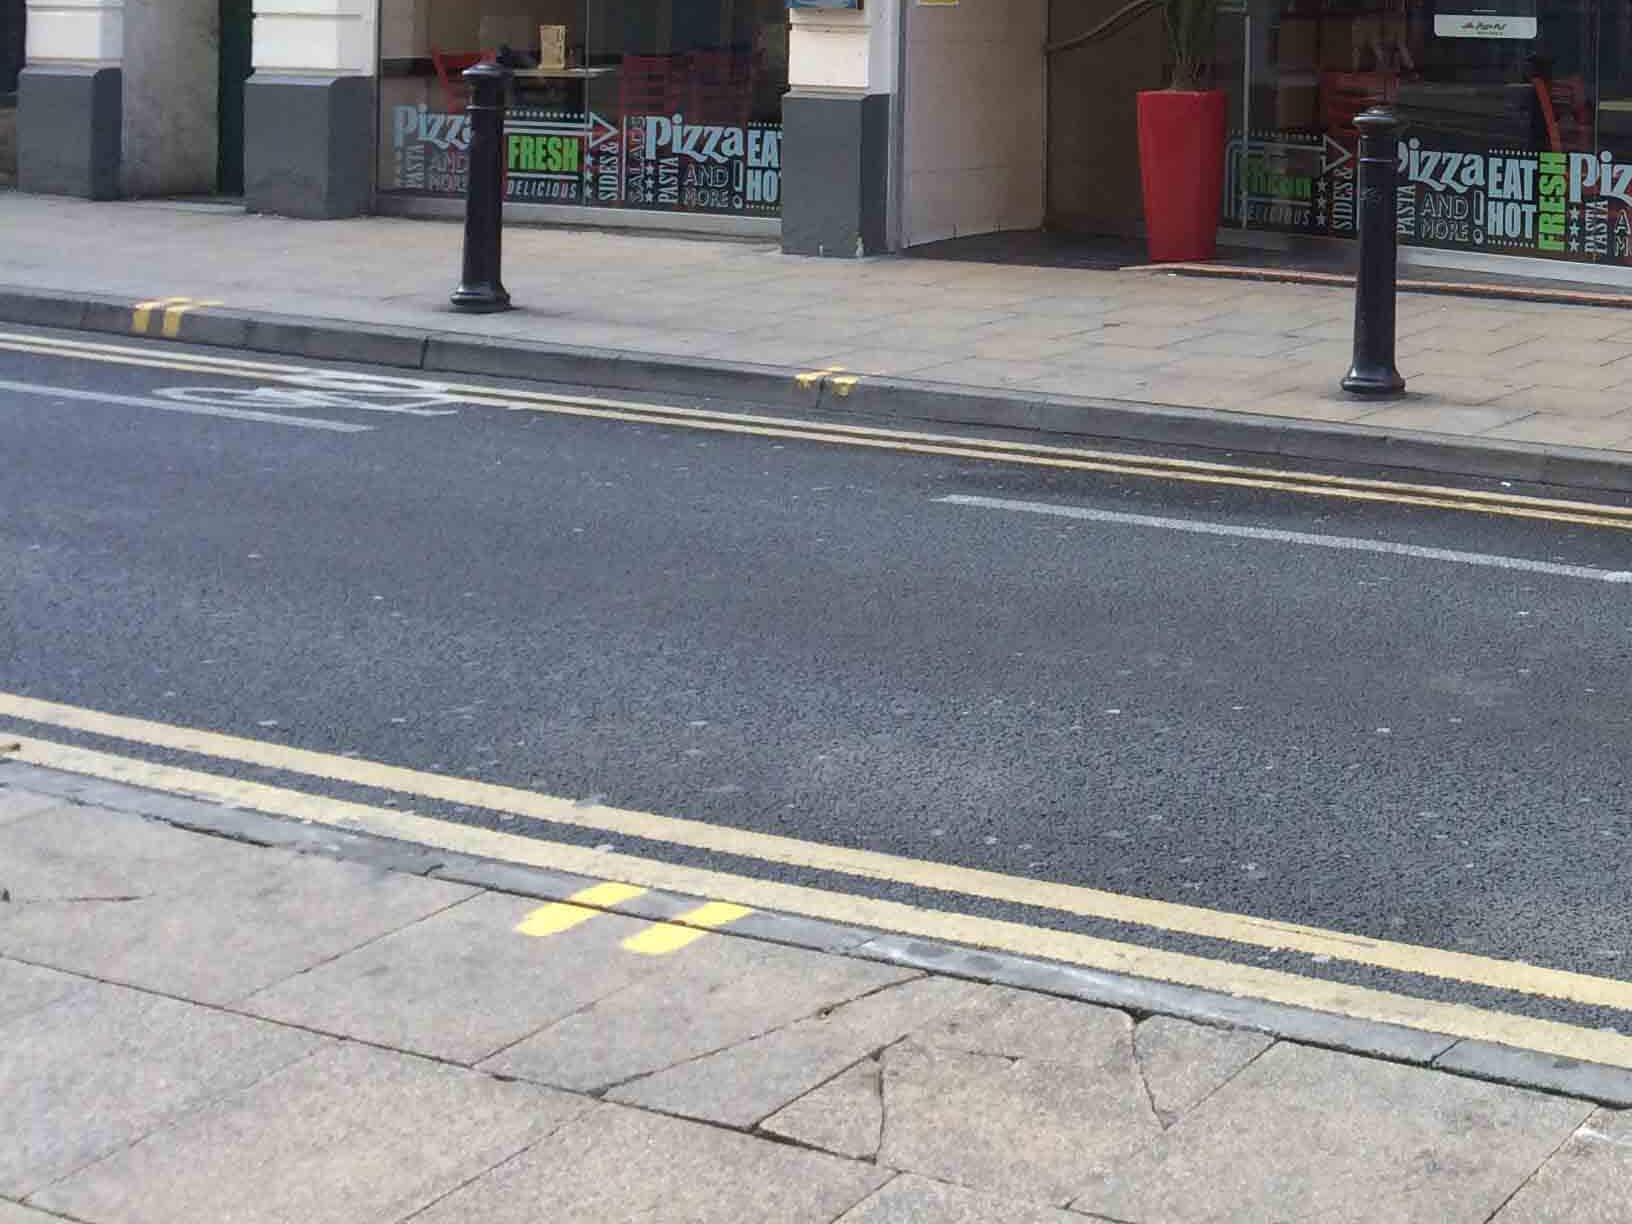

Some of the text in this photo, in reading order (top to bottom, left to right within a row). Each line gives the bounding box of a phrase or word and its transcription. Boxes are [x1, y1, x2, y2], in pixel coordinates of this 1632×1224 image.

[508, 135, 579, 173] FRESH
[629, 115, 646, 202] SALADS
[645, 113, 745, 164] Pizza
[747, 129, 783, 168] EA
[506, 180, 577, 199] DELICIOUS
[600, 156, 619, 201] SIDES
[659, 157, 680, 204] PASTA
[682, 163, 729, 188] AND
[747, 169, 782, 201] HO
[1488, 157, 1538, 201] EAT
[684, 188, 729, 209] MORE
[1333, 181, 1353, 230] SIDES
[1396, 185, 1417, 236] PASTA
[1421, 191, 1469, 220] AND
[1539, 152, 1568, 251] FRESH
[1422, 219, 1469, 242] MORE
[1488, 201, 1537, 240] HOT
[1584, 199, 1608, 255] PASTA
